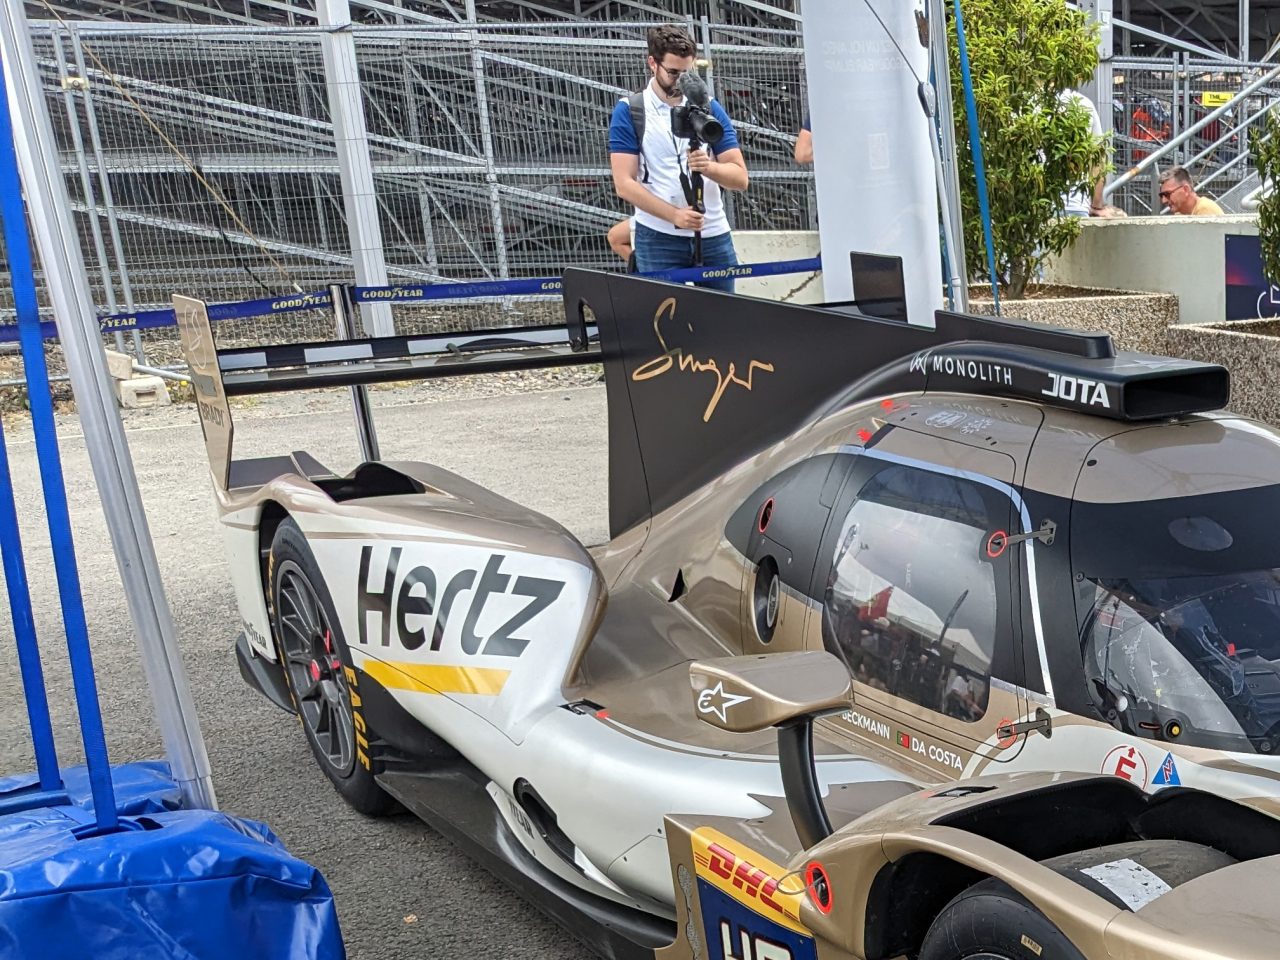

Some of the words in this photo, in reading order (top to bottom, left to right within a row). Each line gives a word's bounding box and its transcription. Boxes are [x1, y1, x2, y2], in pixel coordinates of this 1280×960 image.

[703, 267, 752, 277] GOODYEAR
[362, 288, 423, 299] GOODYEAR
[100, 317, 137, 329] YEAR
[633, 298, 775, 422] Singer
[933, 355, 1013, 385] MONOLITH
[1042, 372, 1110, 408] JOTA
[358, 546, 565, 657] Hertz
[343, 665, 370, 771] EAGLE
[911, 738, 927, 756] DA
[928, 745, 963, 771] COSTA
[708, 842, 784, 914] DHL
